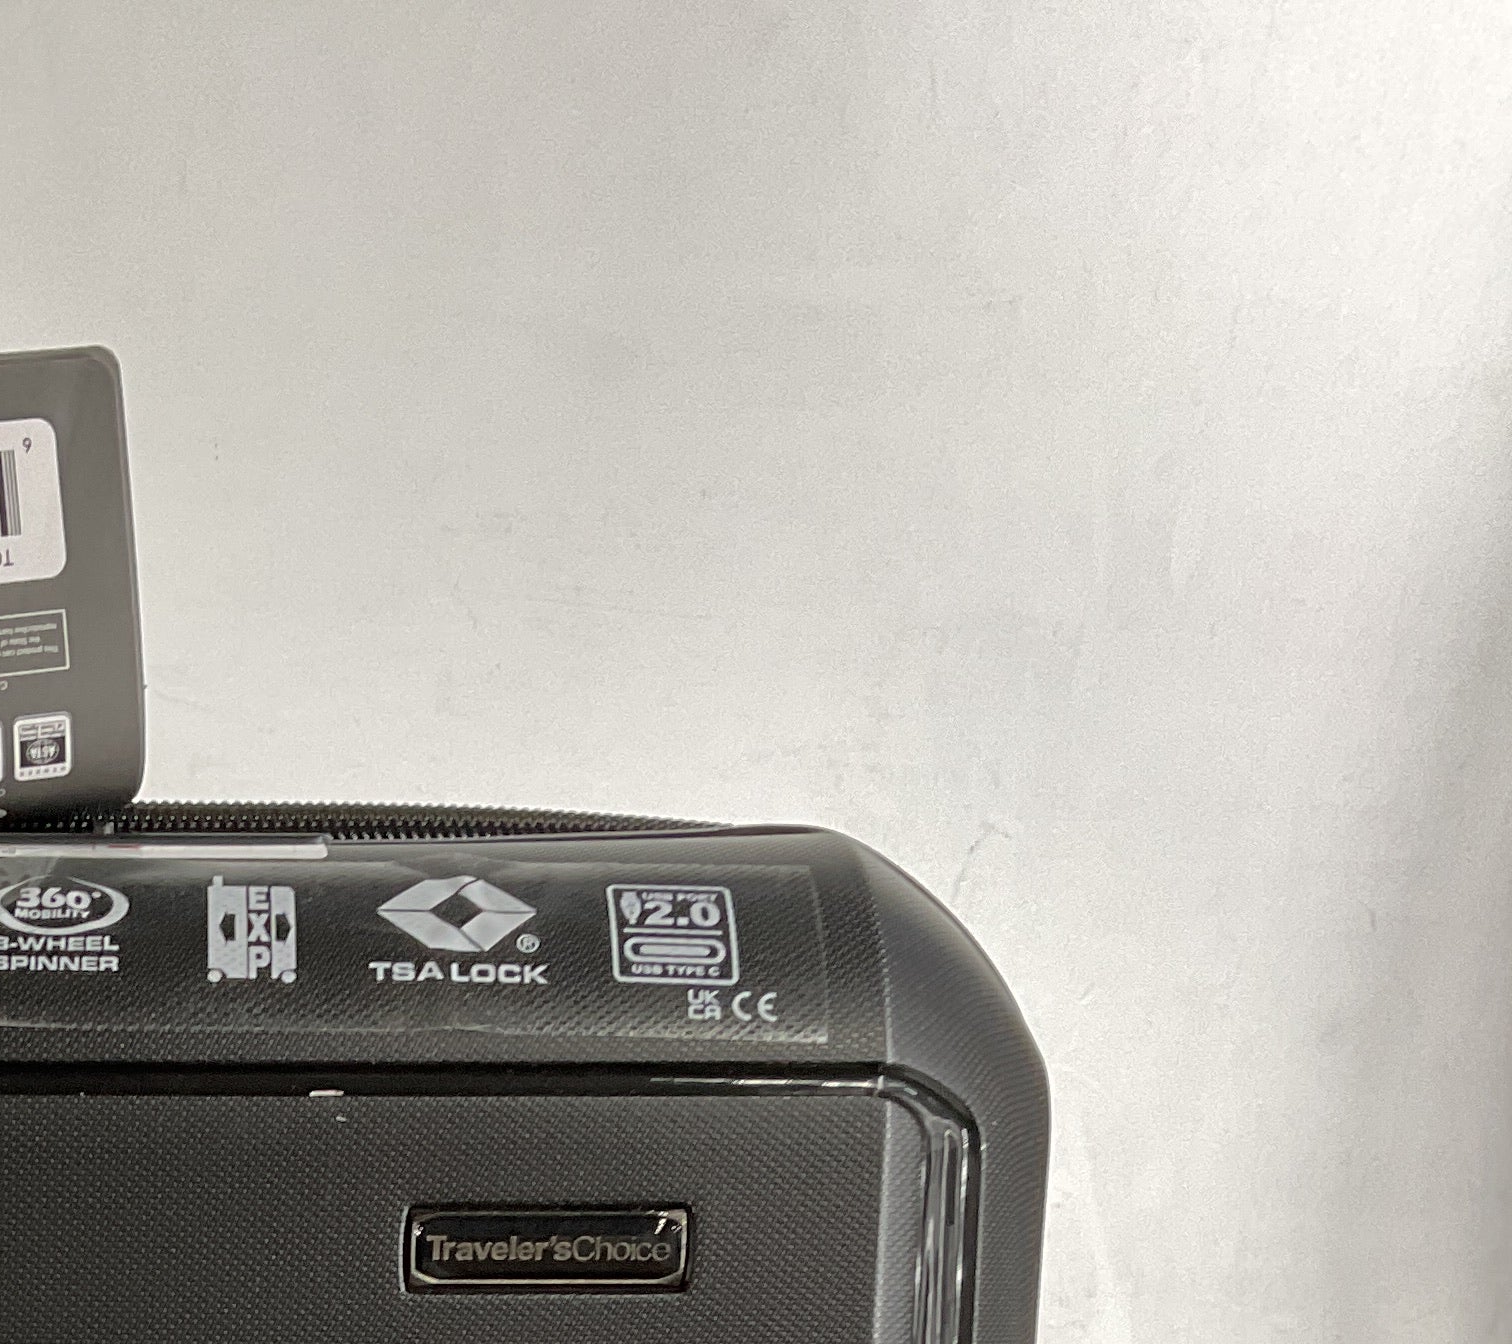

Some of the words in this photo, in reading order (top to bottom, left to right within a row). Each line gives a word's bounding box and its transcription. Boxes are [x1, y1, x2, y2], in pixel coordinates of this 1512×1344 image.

[23, 437, 32, 454] 6
[14, 907, 90, 919] MOBILITY
[643, 900, 721, 928] 2.0
[248, 885, 271, 979] EXP
[368, 961, 445, 984] TSA
[450, 963, 550, 985] LOCK
[631, 963, 663, 976] USB
[665, 965, 706, 977] TYPE
[708, 966, 721, 977] C
[688, 988, 720, 1005] UK
[688, 1004, 722, 1021] CA
